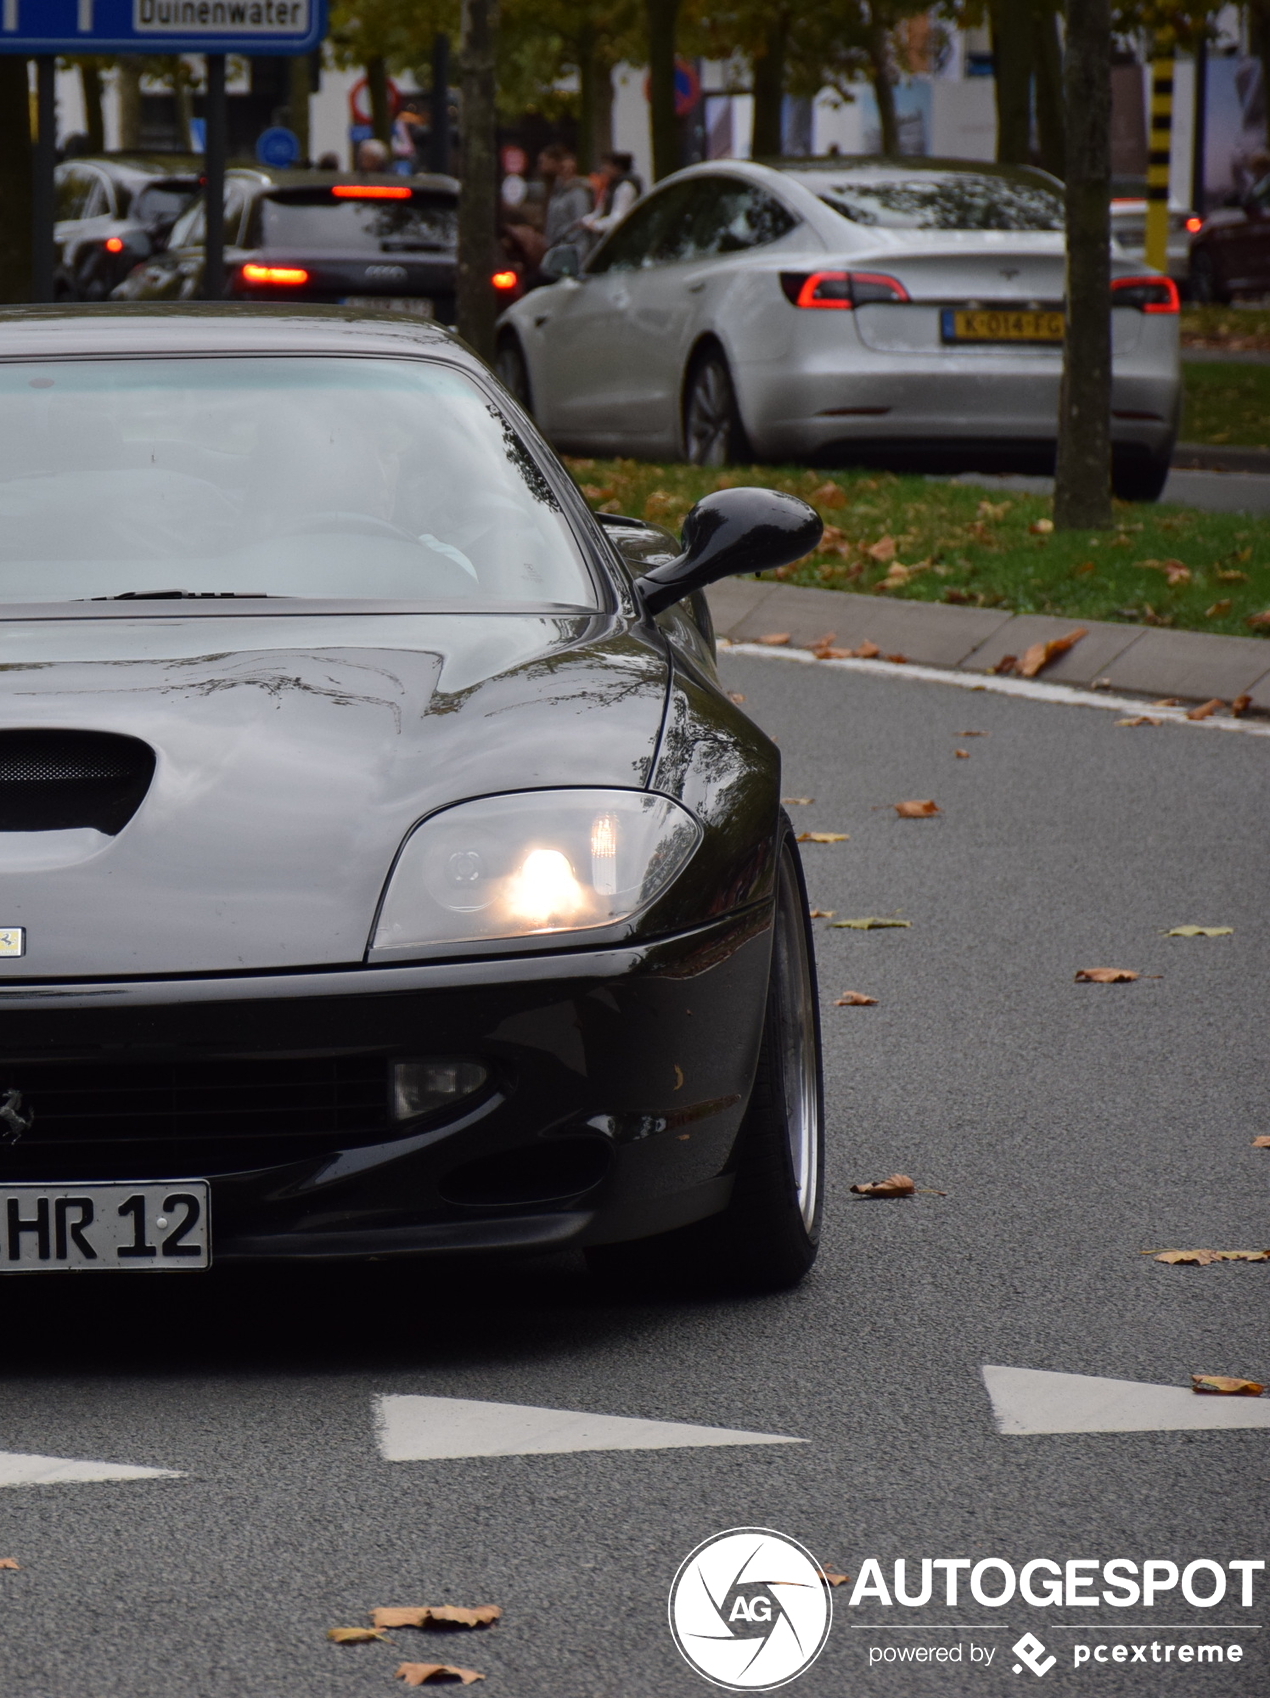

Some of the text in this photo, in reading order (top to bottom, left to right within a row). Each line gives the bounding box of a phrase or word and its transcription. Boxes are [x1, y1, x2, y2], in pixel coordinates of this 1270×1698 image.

[139, 0, 301, 24] Duinenwater
[6, 1195, 98, 1260] HR
[116, 1193, 202, 1258] 12
